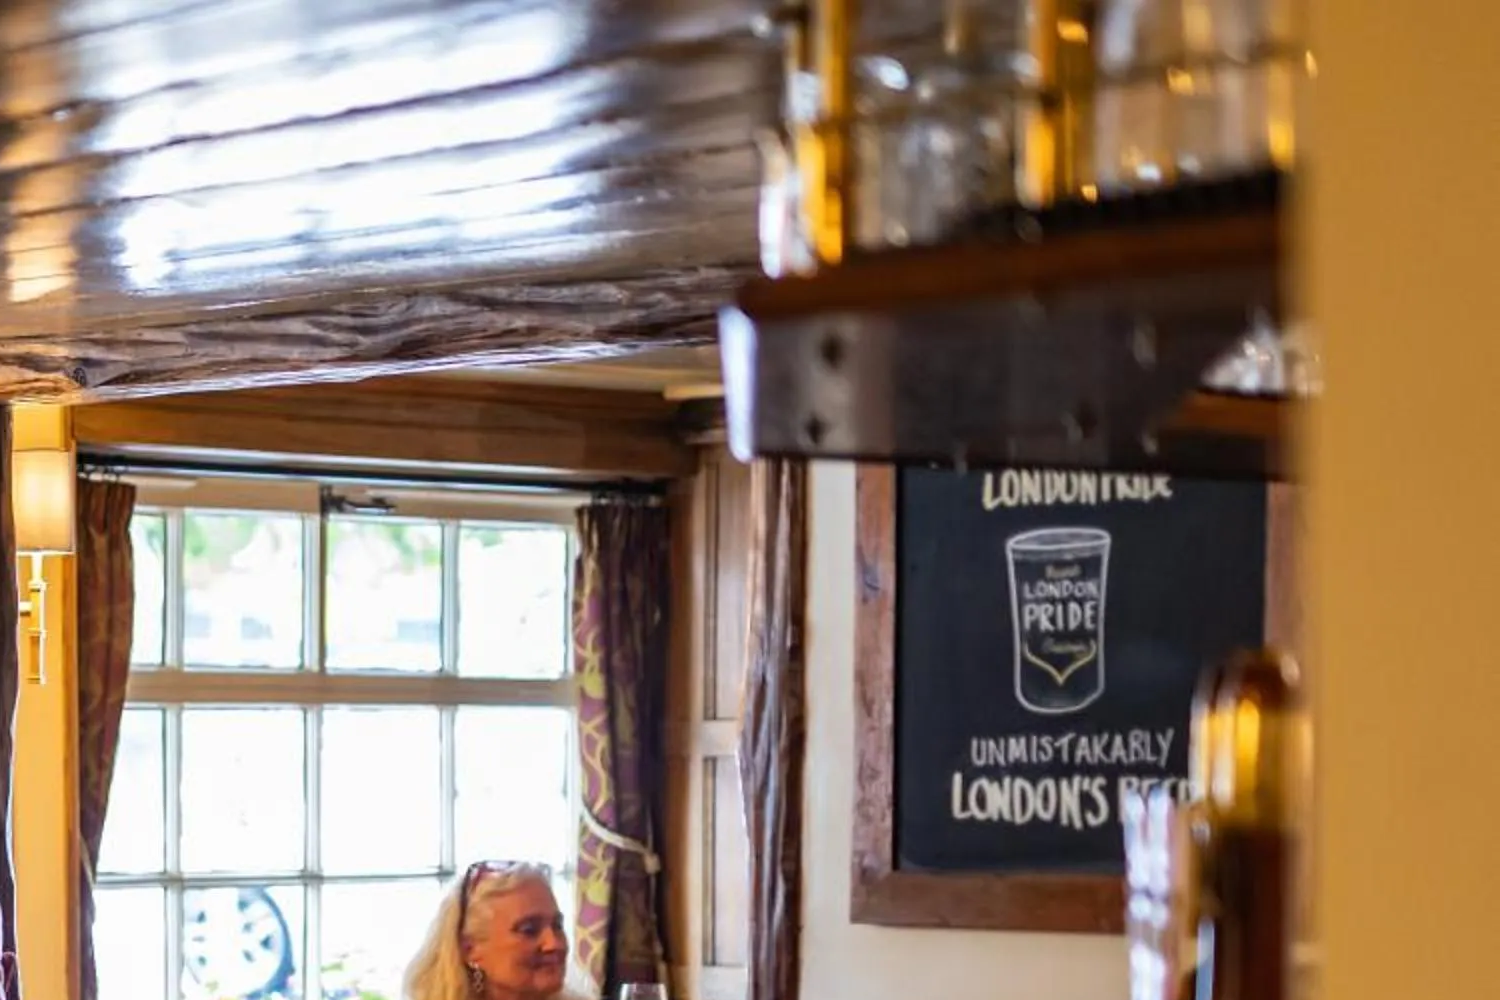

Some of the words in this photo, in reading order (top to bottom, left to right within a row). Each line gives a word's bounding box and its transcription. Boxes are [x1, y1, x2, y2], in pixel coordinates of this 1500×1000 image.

[983, 468, 1097, 511] LONDON
[1023, 580, 1100, 600] LONDON
[1023, 601, 1097, 632] PRIDE
[971, 728, 1175, 769] UNMISTAKABLY
[952, 771, 1111, 831] LONDON'S
